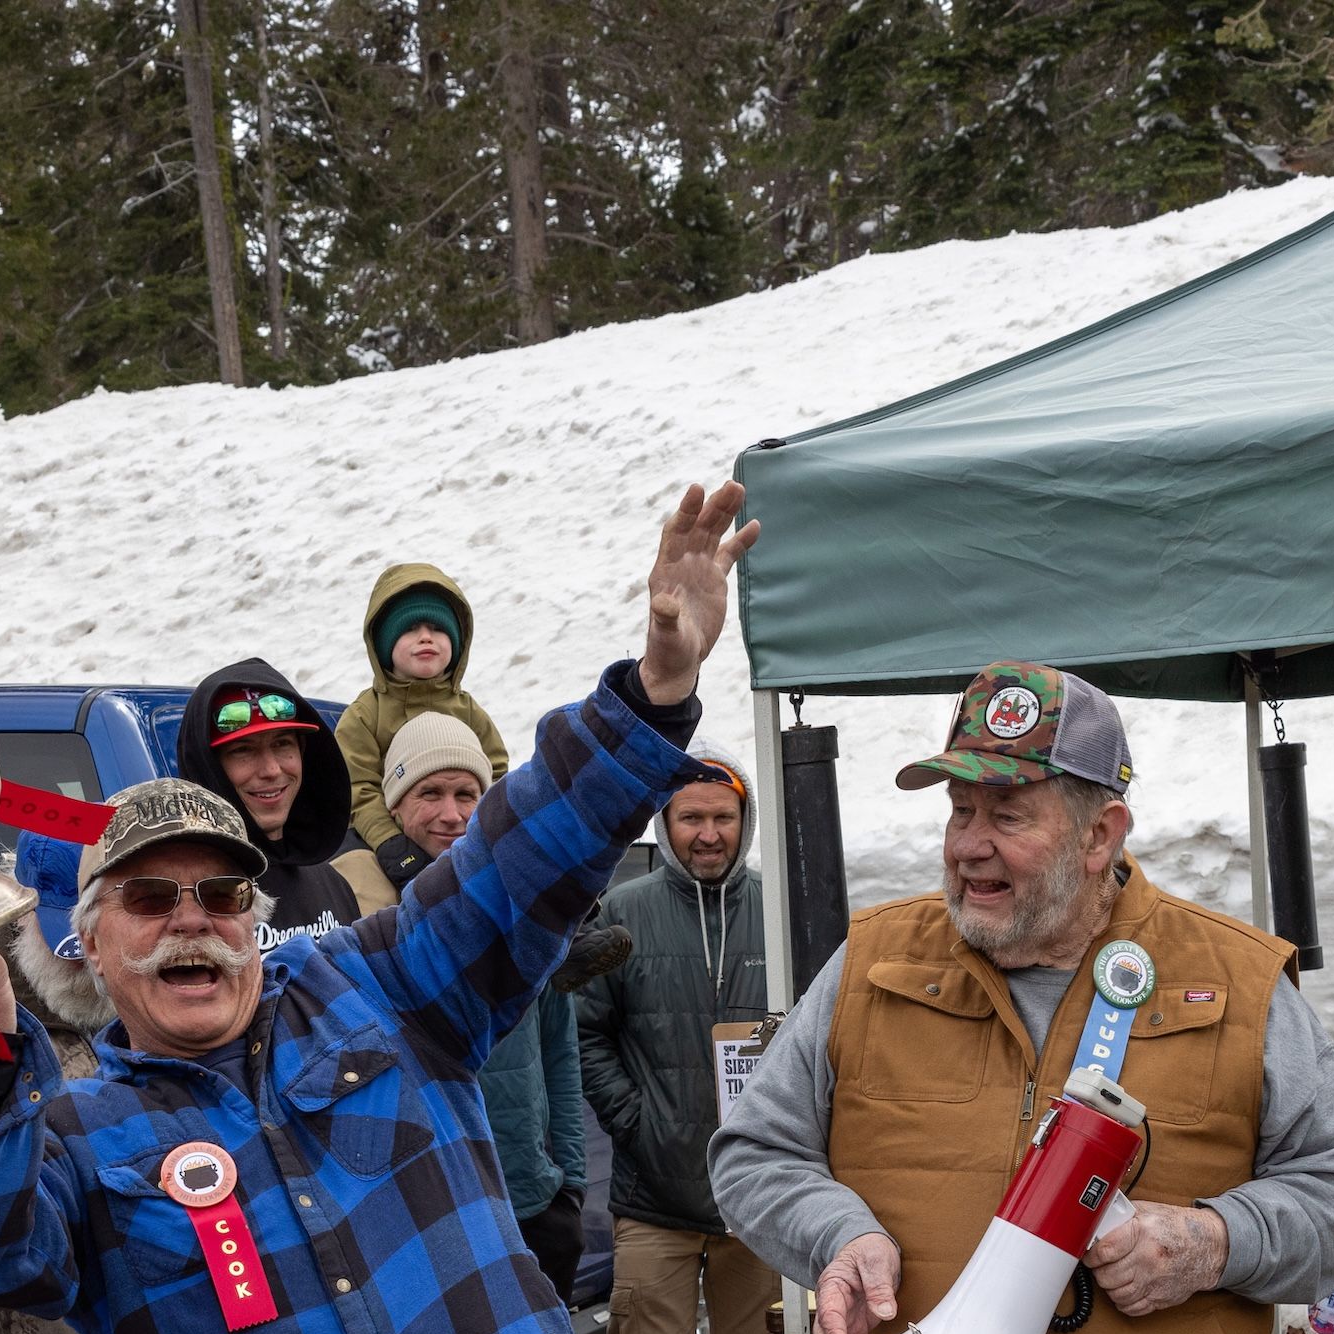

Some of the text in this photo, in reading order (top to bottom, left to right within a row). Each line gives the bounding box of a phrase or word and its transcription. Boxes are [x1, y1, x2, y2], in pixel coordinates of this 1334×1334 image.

[134, 796, 218, 827] Midway
[1097, 945, 1156, 991] THE GREAT YUBA PASS
[1111, 991, 1147, 1005] COOK-OFF
[1087, 1011, 1120, 1076] JUDG
[215, 1220, 253, 1299] COOK
